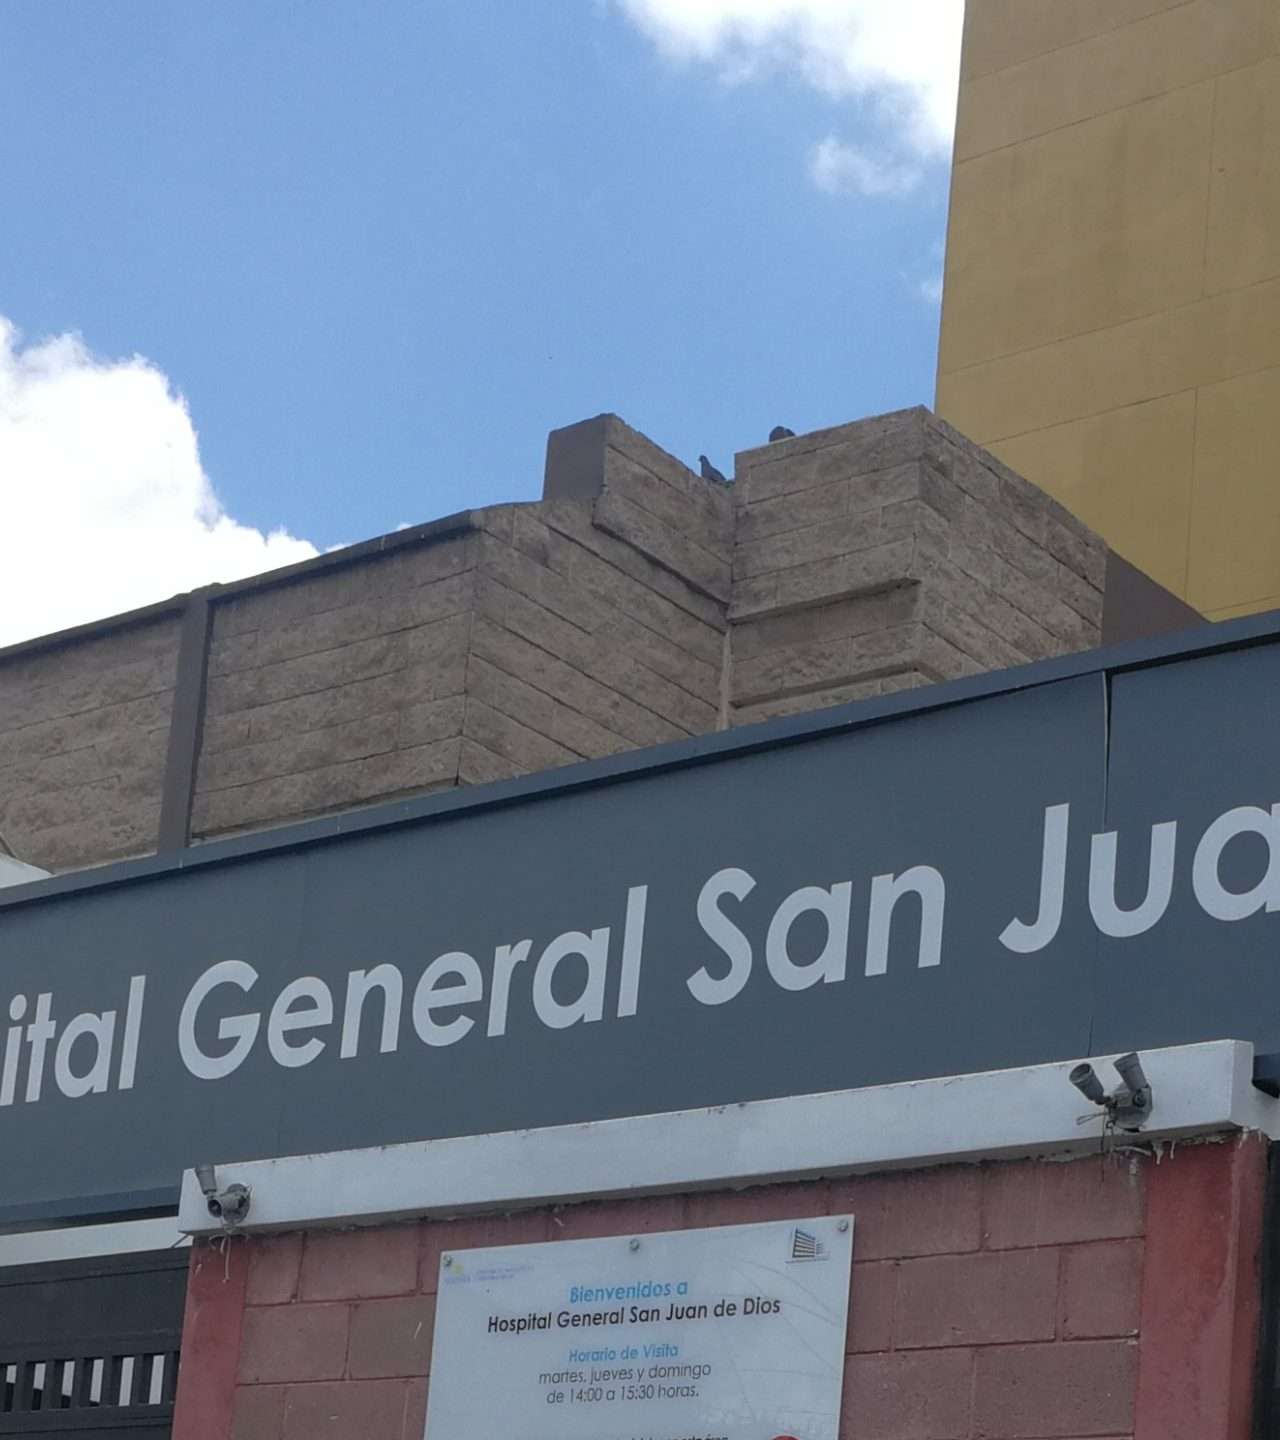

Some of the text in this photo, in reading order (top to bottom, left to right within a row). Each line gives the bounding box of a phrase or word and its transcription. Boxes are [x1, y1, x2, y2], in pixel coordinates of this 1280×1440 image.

[177, 884, 649, 1081] General
[686, 867, 946, 1006] San
[570, 1281, 688, 1303] Bienvenidos a
[488, 1296, 781, 1334] Hospital General San Juan de Dios
[569, 1344, 679, 1362] Horario de Visita
[590, 1367, 633, 1385] jueves
[637, 1368, 645, 1382] y
[648, 1363, 712, 1380] domingo
[546, 1383, 700, 1404] de 14:00 a 15:30 horas.
